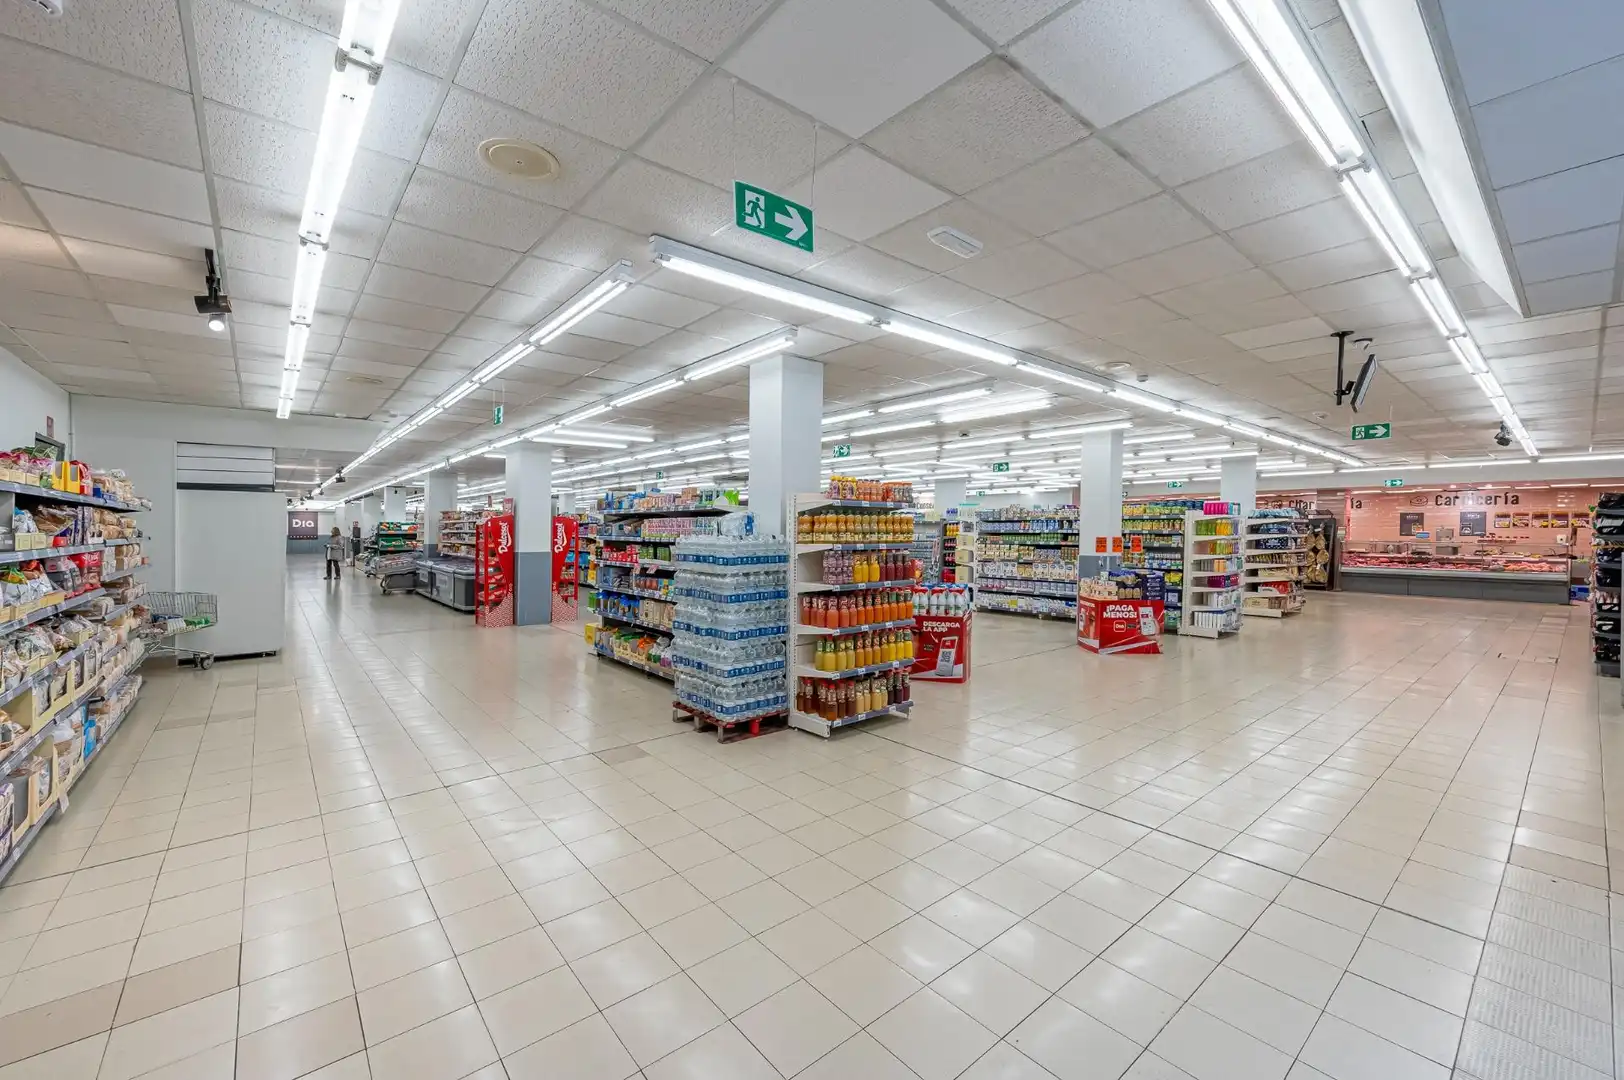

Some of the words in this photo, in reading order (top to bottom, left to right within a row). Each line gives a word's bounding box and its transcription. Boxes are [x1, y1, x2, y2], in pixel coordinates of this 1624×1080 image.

[1435, 491, 1520, 507] Carnicería
[1106, 604, 1134, 612] ¡PAGA
[1103, 611, 1137, 619] MENOS!
[923, 620, 960, 629] DESCARGA
